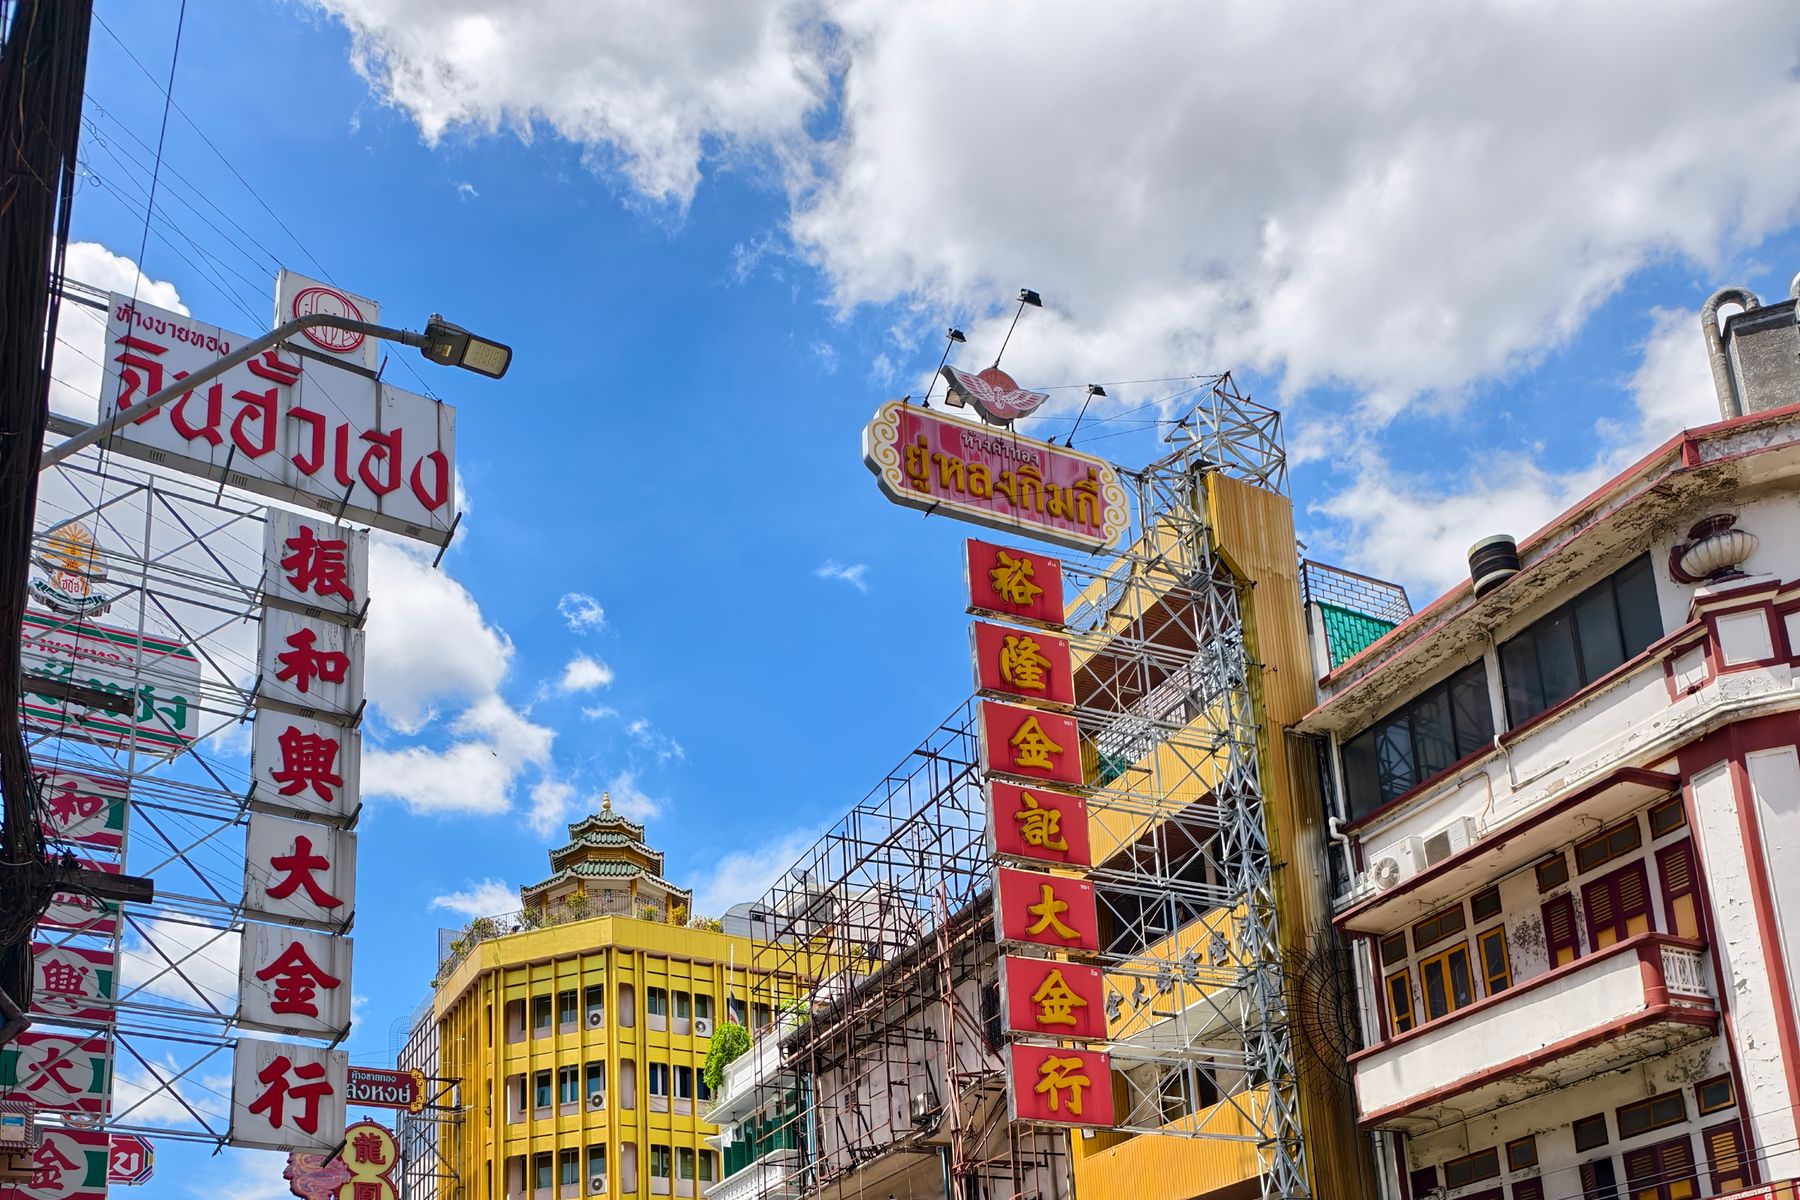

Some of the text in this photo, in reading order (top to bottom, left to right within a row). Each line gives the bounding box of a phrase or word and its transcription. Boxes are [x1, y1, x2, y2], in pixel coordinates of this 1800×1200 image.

[115, 303, 230, 356] ห้างขายทอง
[961, 431, 1040, 467] ห้างค้าทอง
[904, 434, 1100, 528] ยู่หลงกิมกี่
[346, 1079, 411, 1104] ล่งหงษ์
